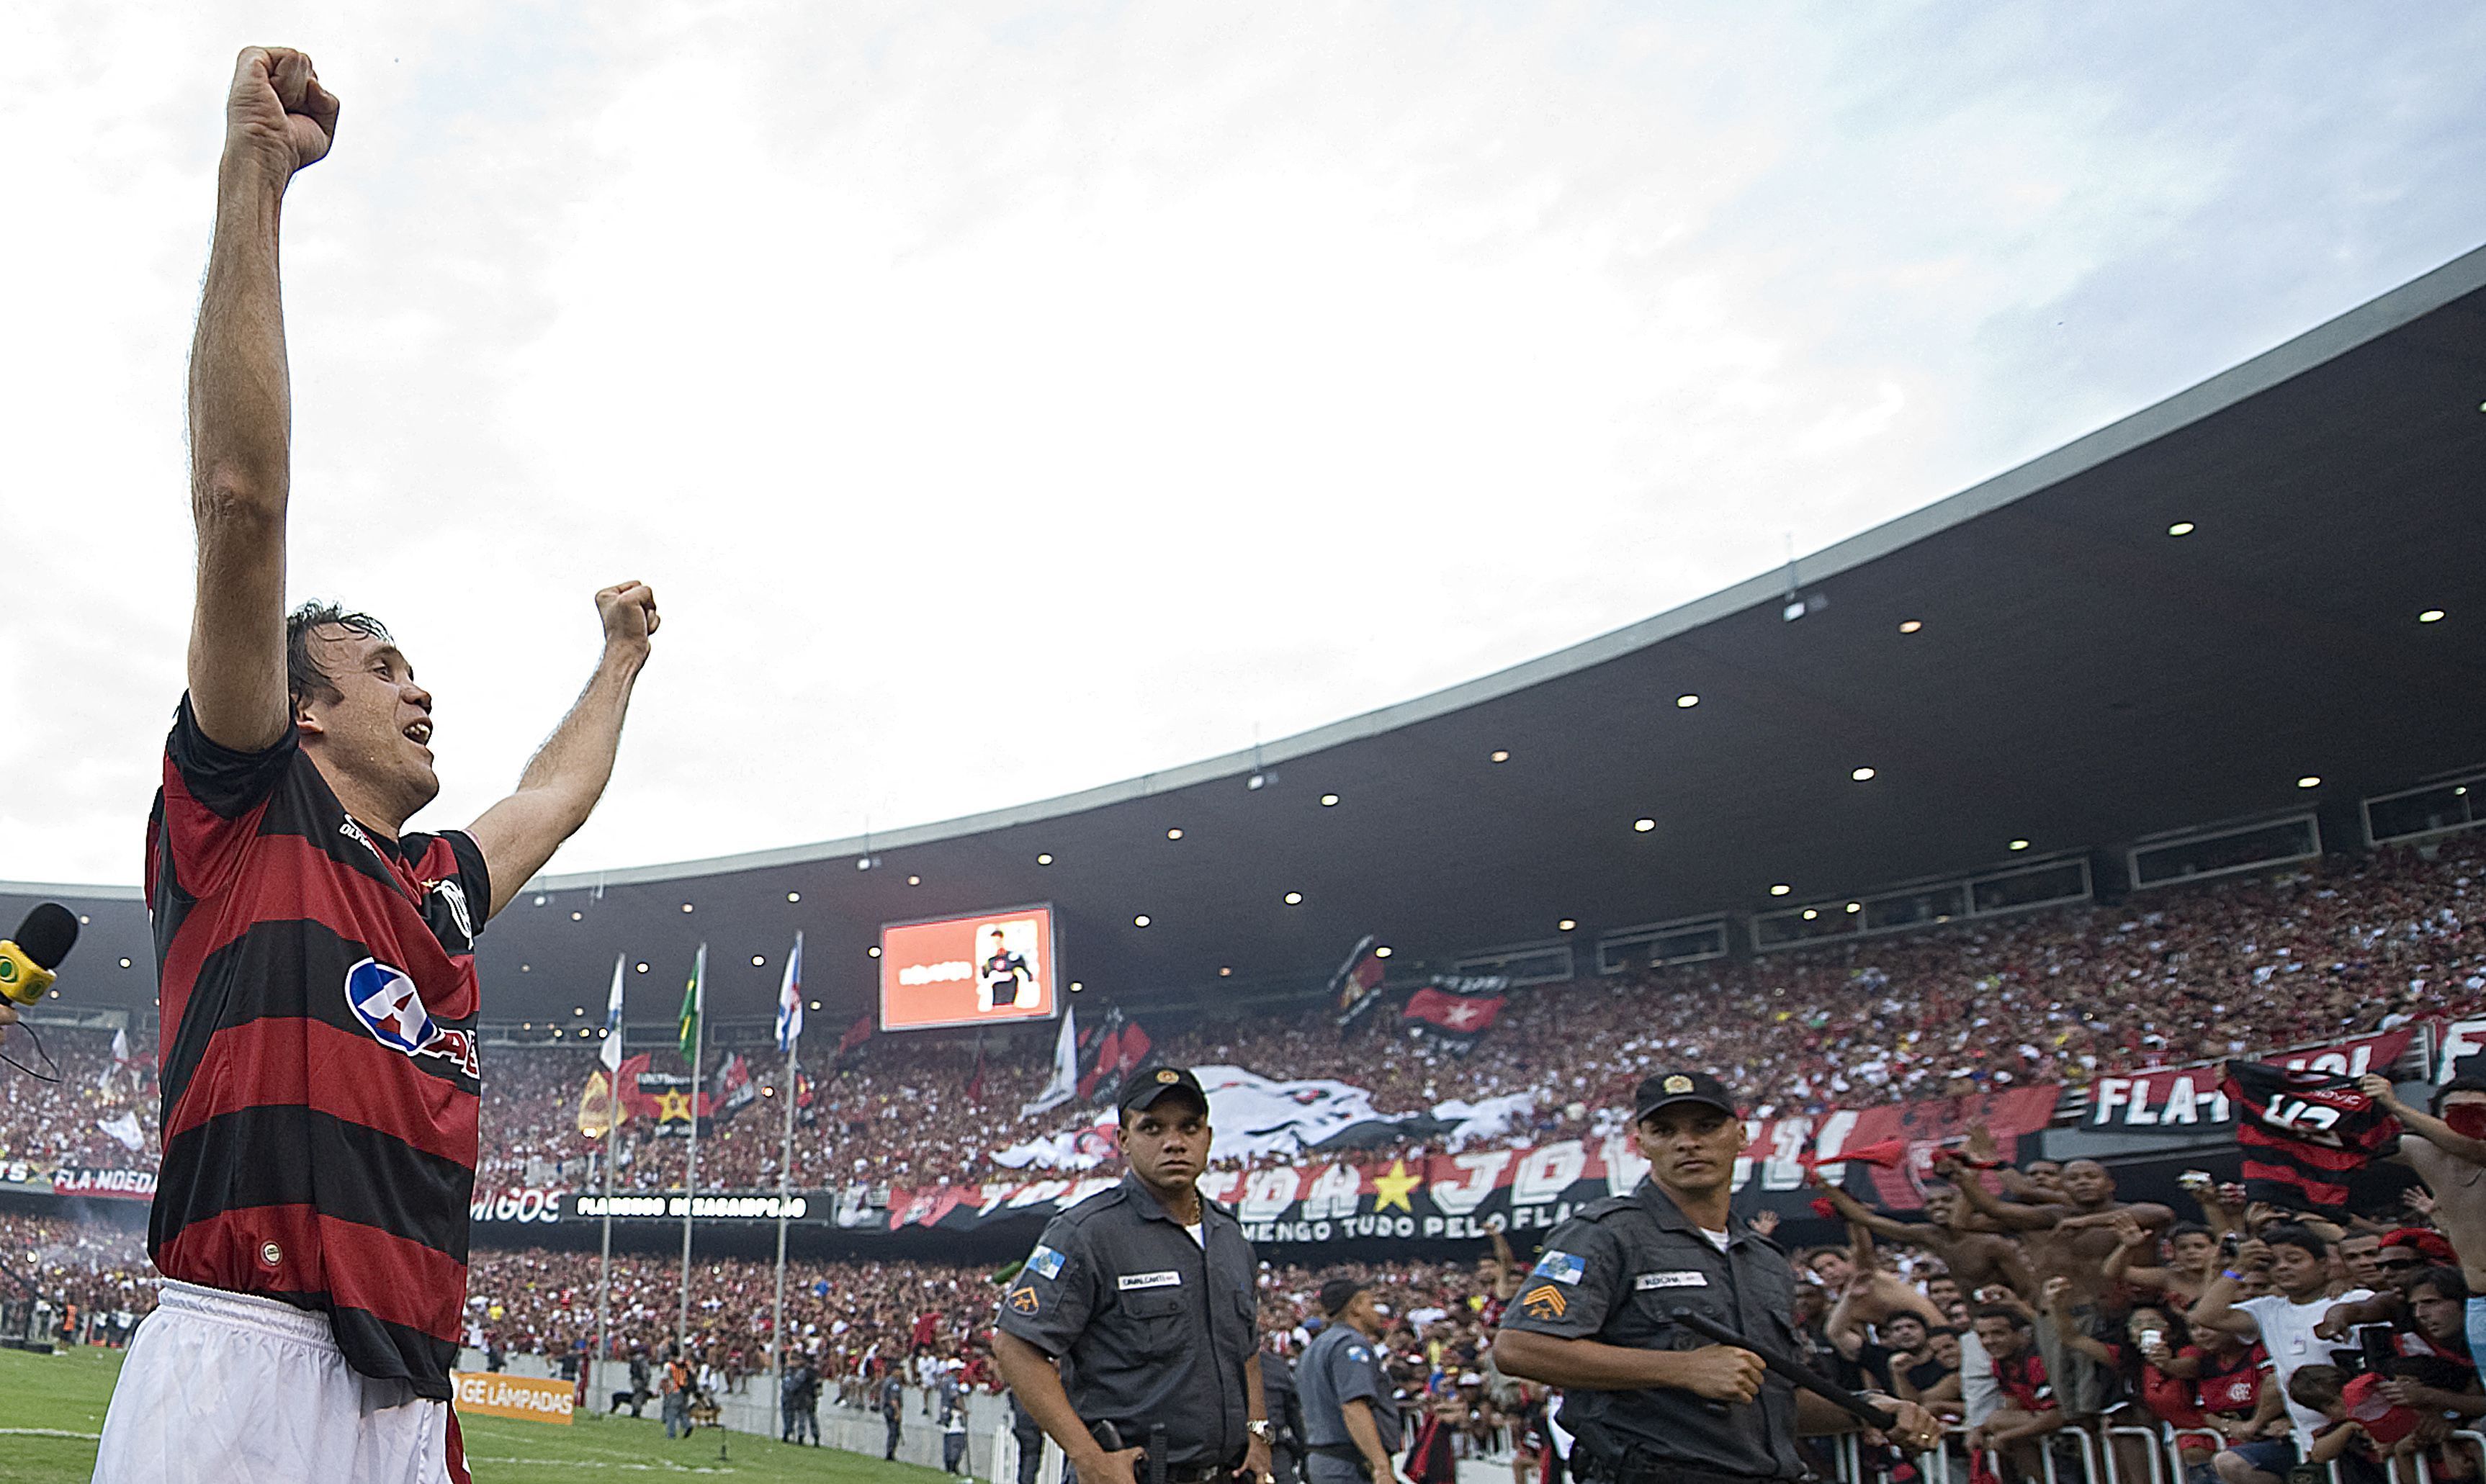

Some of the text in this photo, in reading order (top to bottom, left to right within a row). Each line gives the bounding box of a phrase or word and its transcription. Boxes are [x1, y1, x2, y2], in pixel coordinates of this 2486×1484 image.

[1341, 1215, 1415, 1238] TUDO
[1422, 1212, 1507, 1238] PELO
[461, 1378, 573, 1415] GE LÂMPADAS
